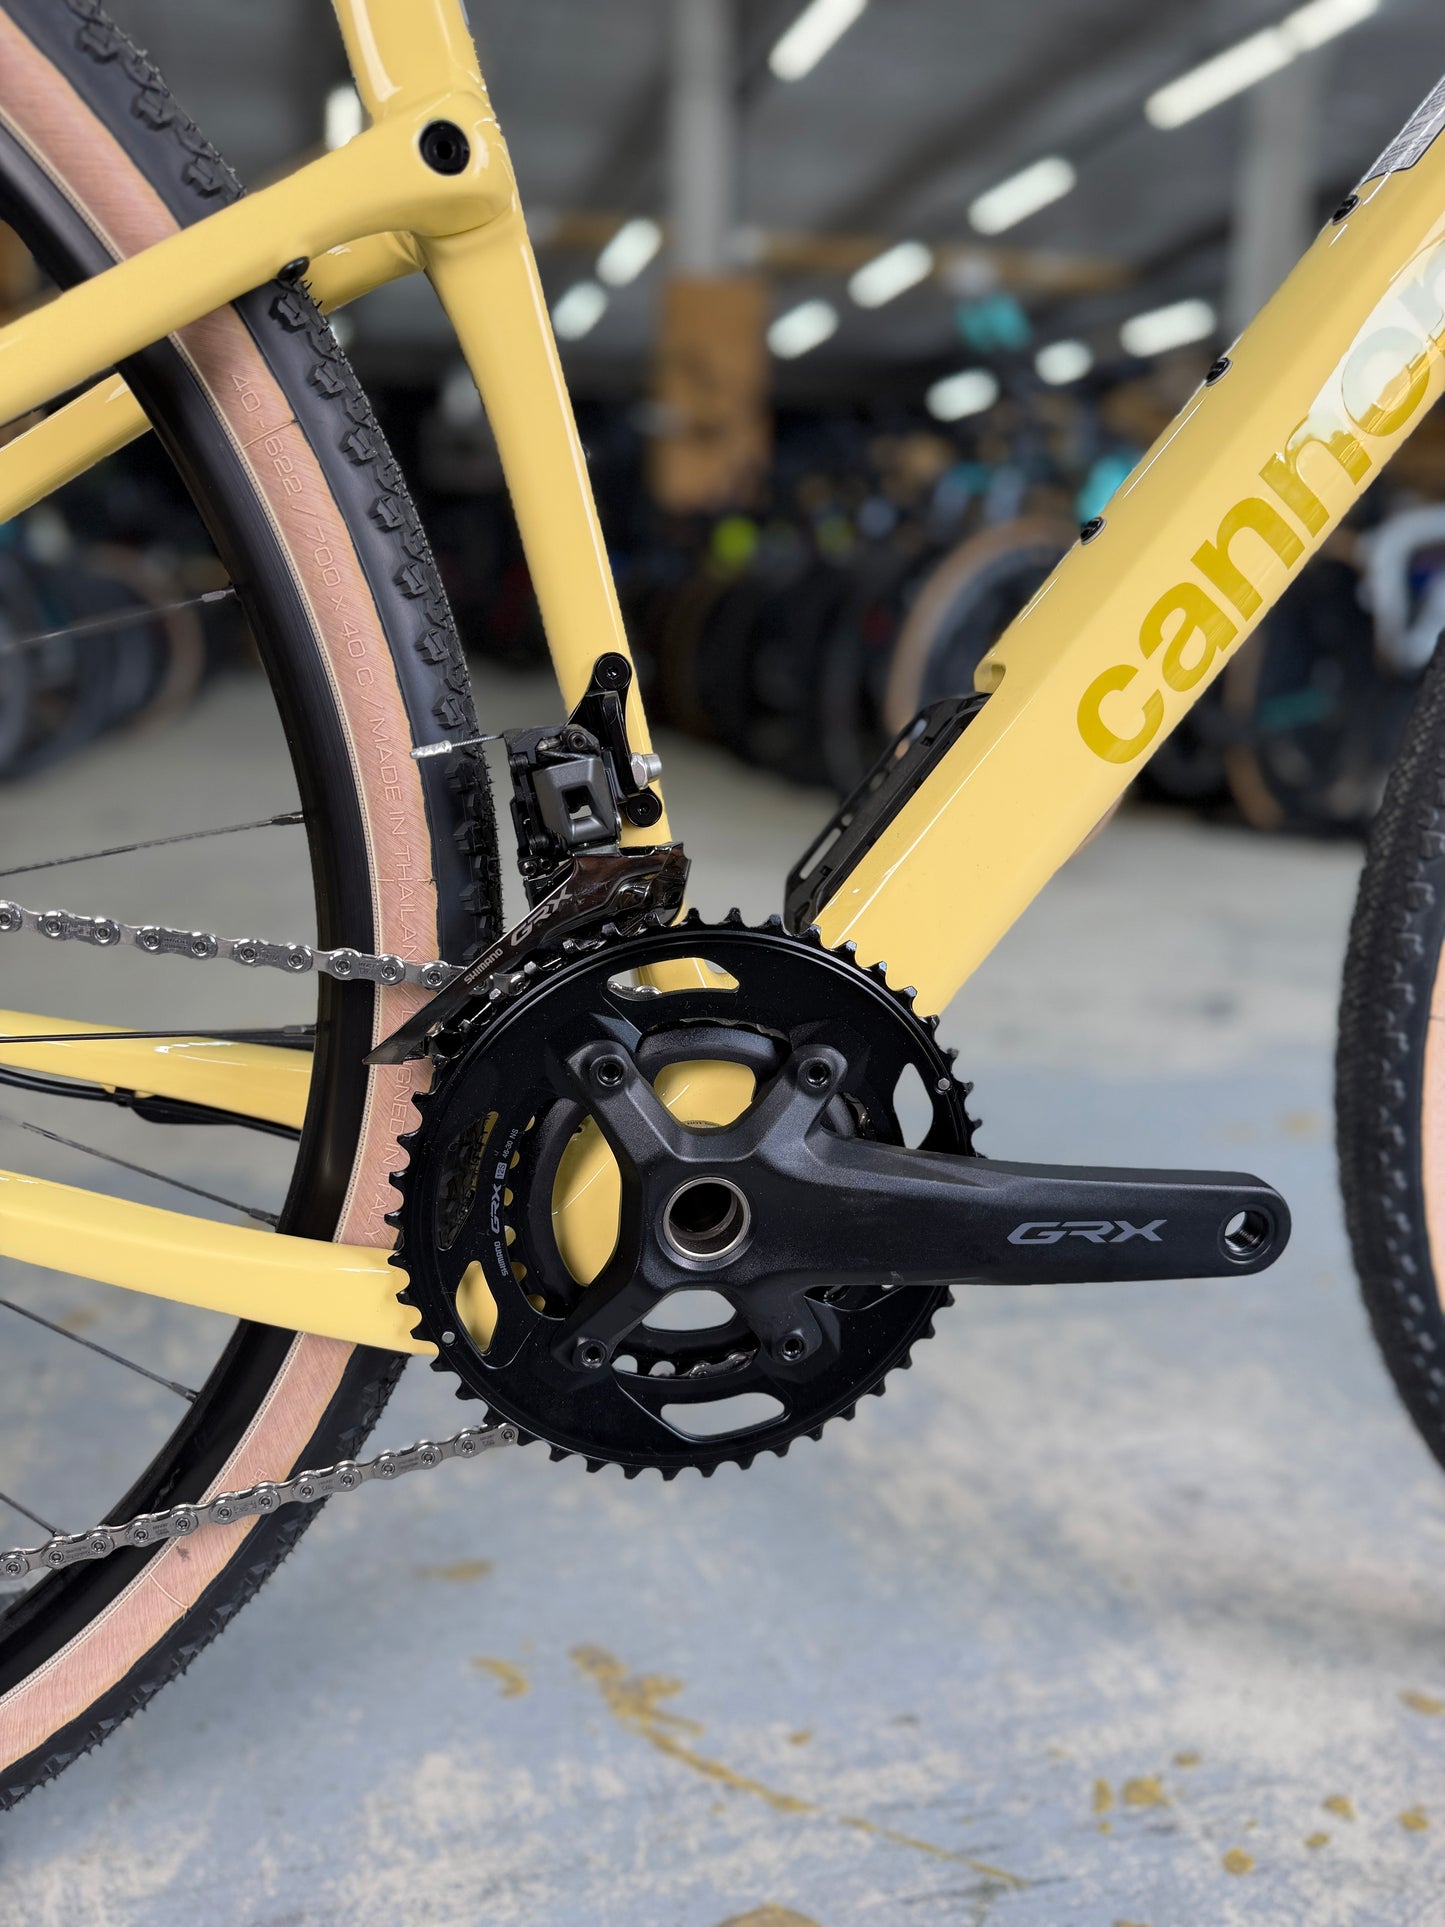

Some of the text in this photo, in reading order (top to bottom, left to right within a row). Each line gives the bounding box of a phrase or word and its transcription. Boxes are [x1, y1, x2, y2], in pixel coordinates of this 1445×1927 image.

[305, 526, 341, 587] 700
[369, 717, 402, 801] MADE
[389, 810, 408, 836] IN
[394, 844, 419, 963] THAILAN
[463, 886, 573, 985] SHIMANO GRX
[382, 1142, 401, 1167] IN
[509, 1128, 519, 1140] NS
[494, 1162, 507, 1179] 12S
[364, 1171, 394, 1244] ITALY
[490, 1183, 502, 1235] GRX
[1006, 1219, 1168, 1245] GRX
[493, 1241, 509, 1277] SHIMANO
